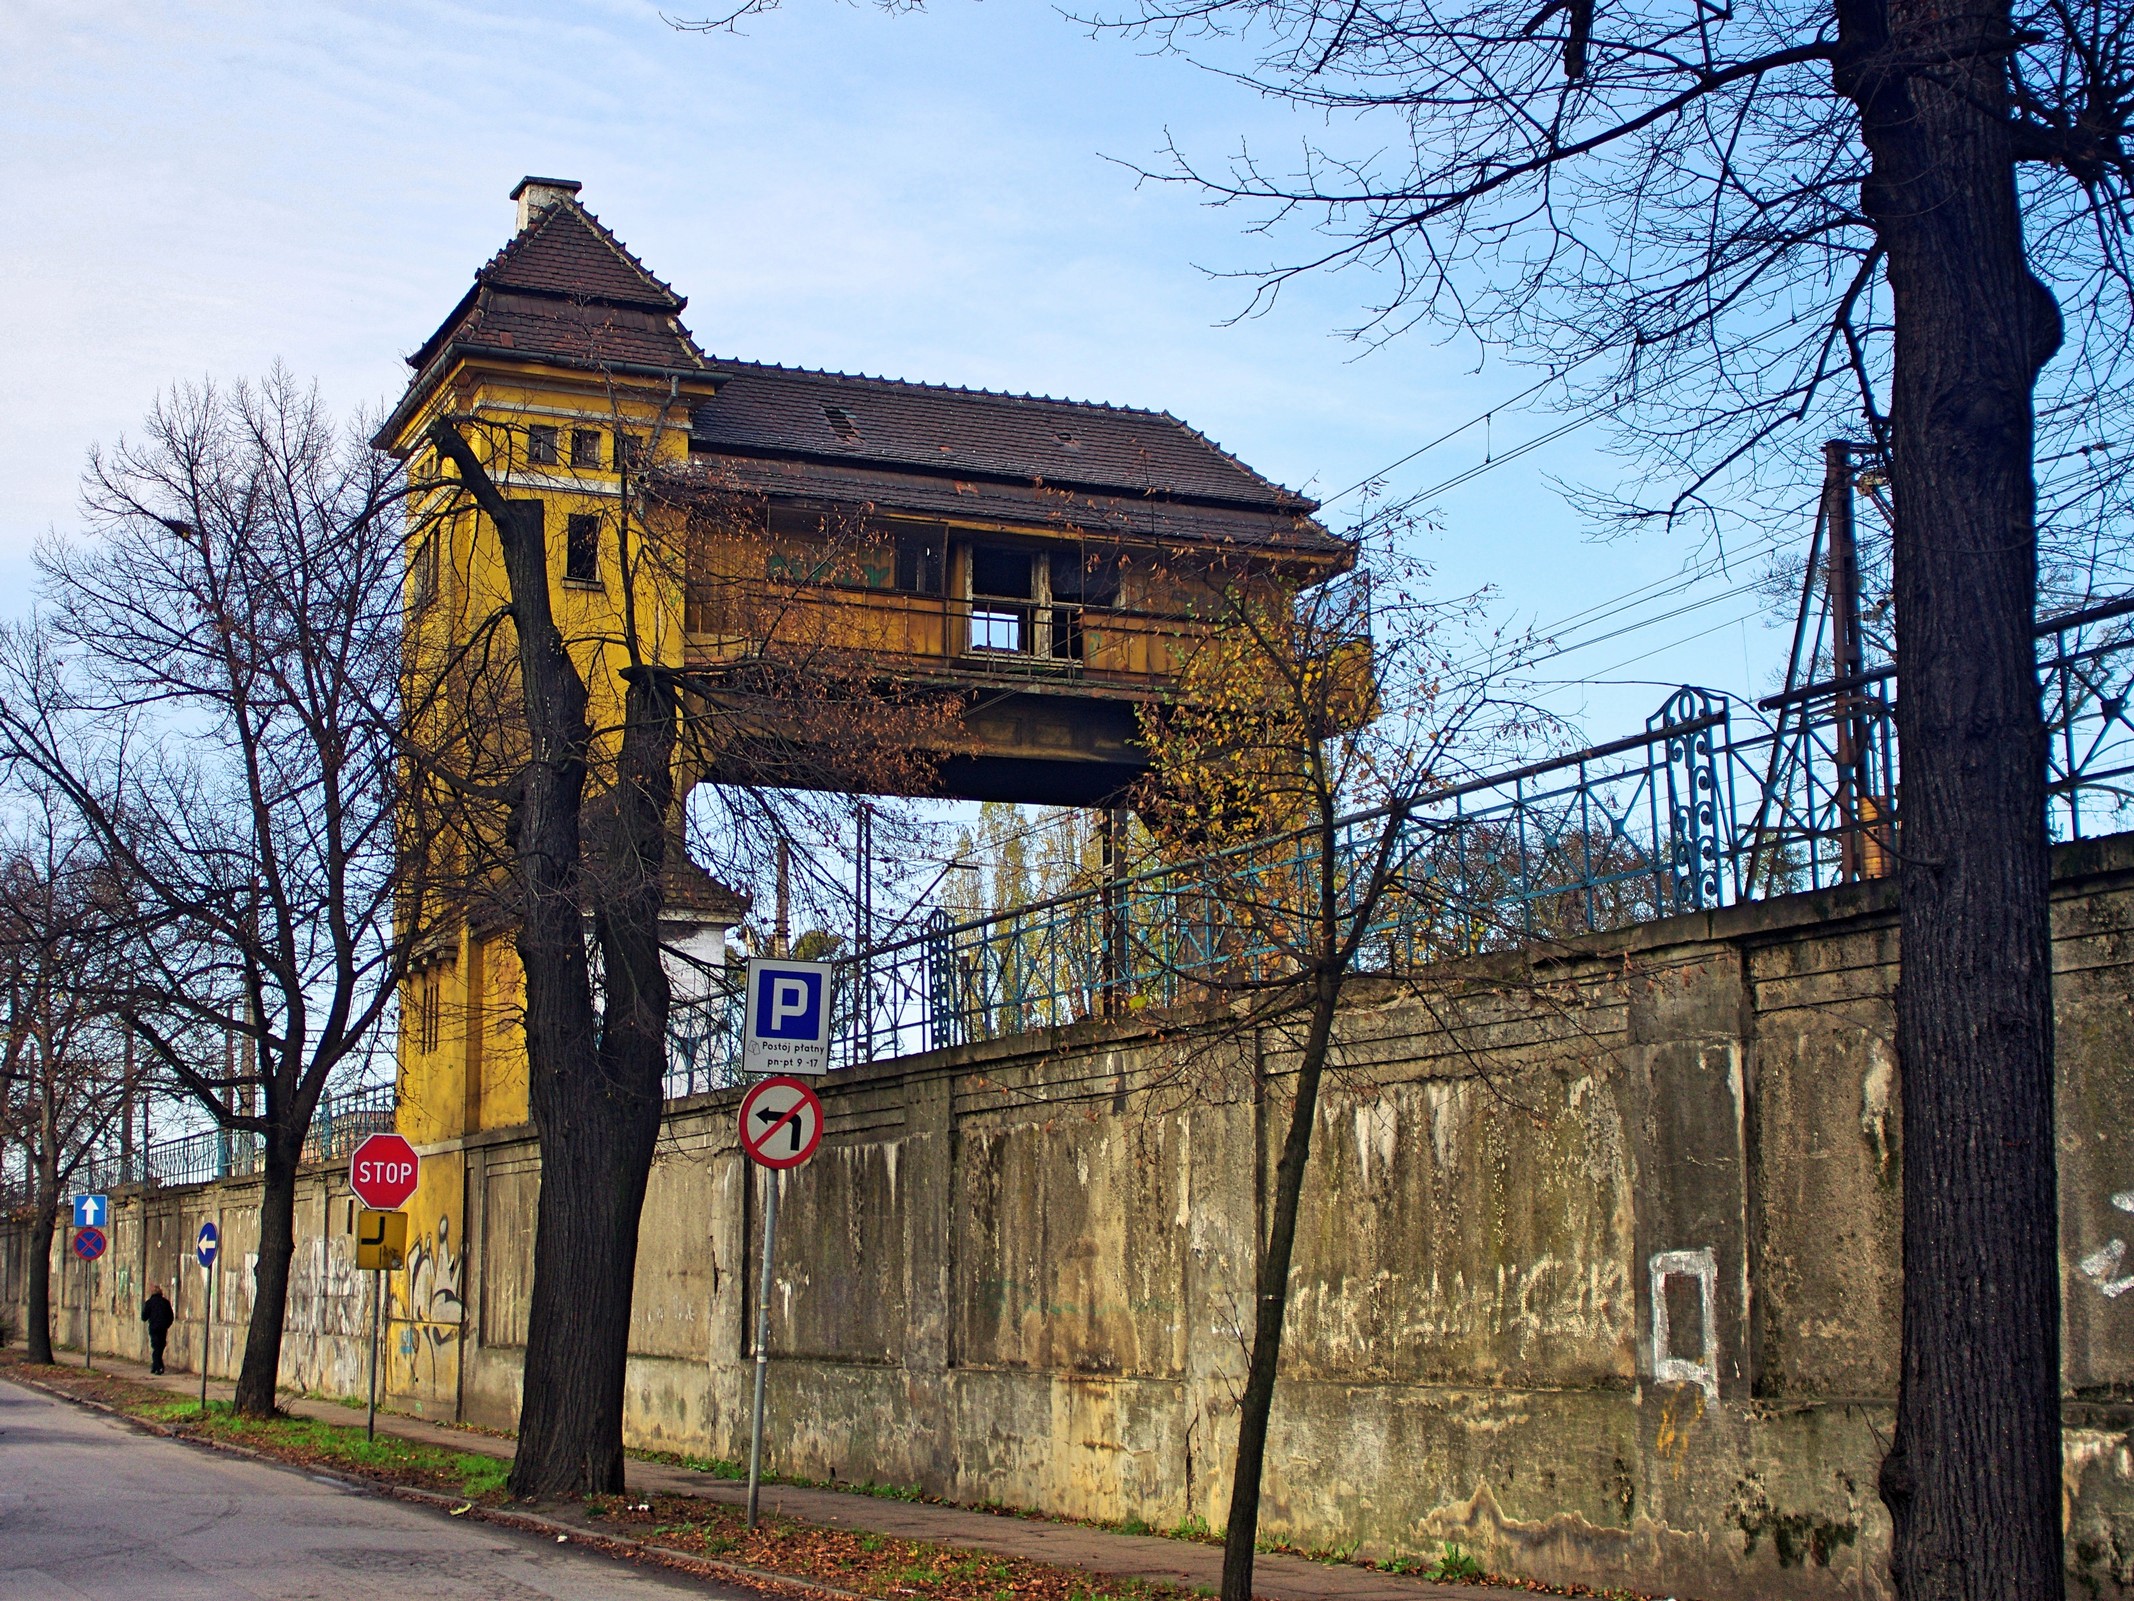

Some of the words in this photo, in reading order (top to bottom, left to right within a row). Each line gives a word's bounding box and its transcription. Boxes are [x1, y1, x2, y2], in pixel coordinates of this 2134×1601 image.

[770, 977, 808, 1031] P
[762, 1041, 791, 1053] Postój
[794, 1043, 825, 1055] płatny
[768, 1058, 793, 1068] pn-pt
[797, 1058, 803, 1067] 9
[359, 1161, 413, 1185] STOP
